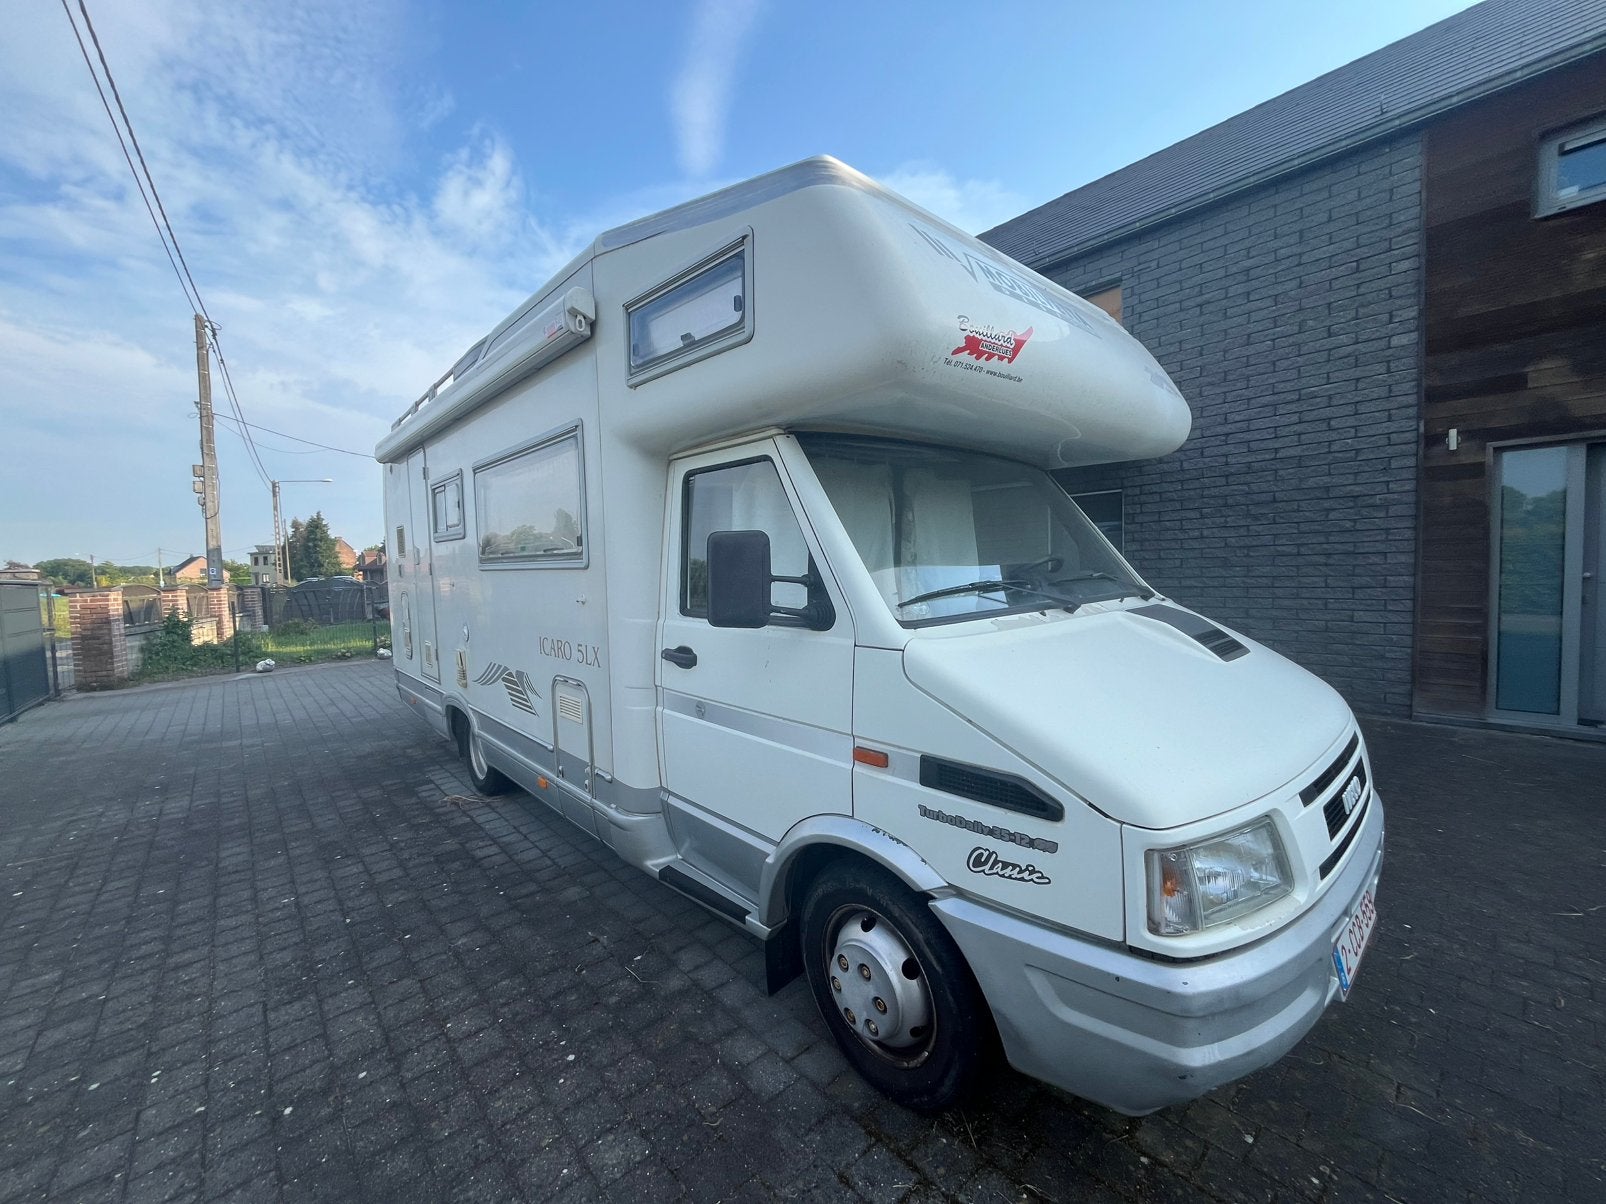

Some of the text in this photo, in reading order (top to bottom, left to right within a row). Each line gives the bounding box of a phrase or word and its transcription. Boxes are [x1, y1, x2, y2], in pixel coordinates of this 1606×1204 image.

[980, 342, 1012, 356] ANDERLUES
[539, 636, 601, 668] ICARO 5LX
[918, 804, 991, 836] TurboDaily
[966, 846, 1051, 885] Classic
